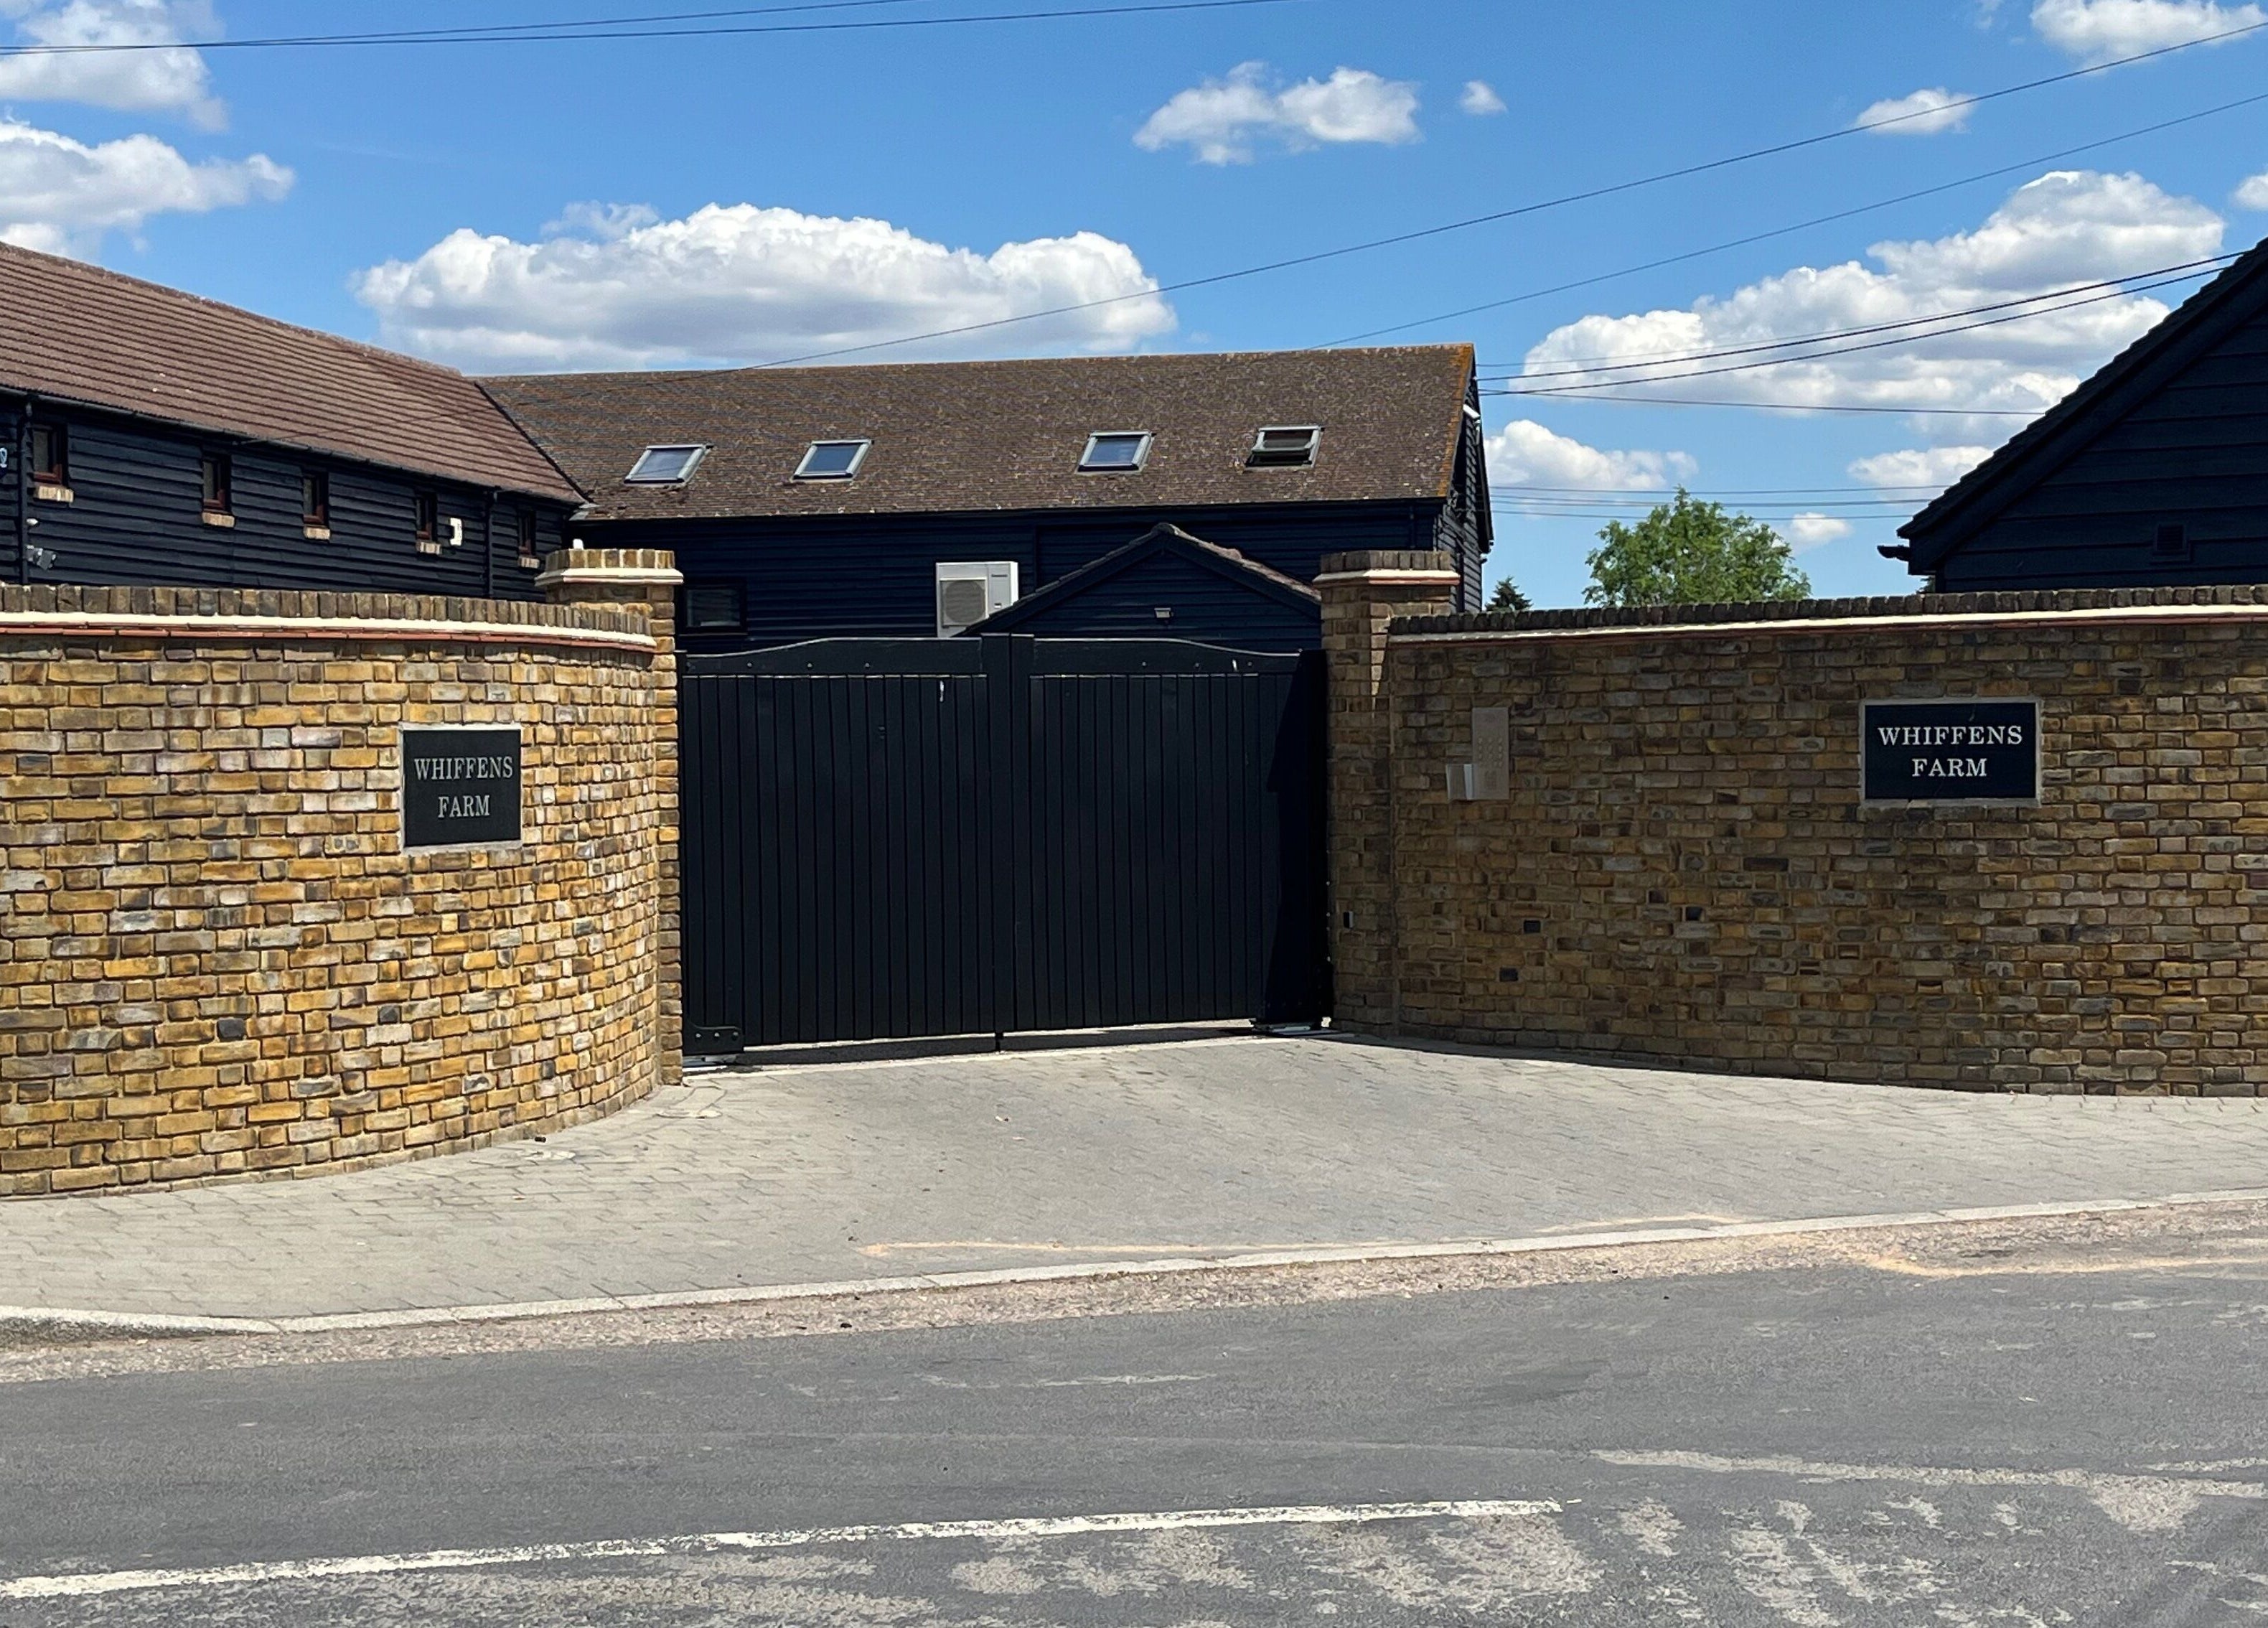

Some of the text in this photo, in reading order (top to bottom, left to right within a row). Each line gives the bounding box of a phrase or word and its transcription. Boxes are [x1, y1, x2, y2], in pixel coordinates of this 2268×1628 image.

[1878, 725, 2023, 745] WHIFFENS
[414, 756, 513, 780] WHIFFENS
[1912, 758, 1987, 777] FARM
[438, 795, 490, 818] FARM
